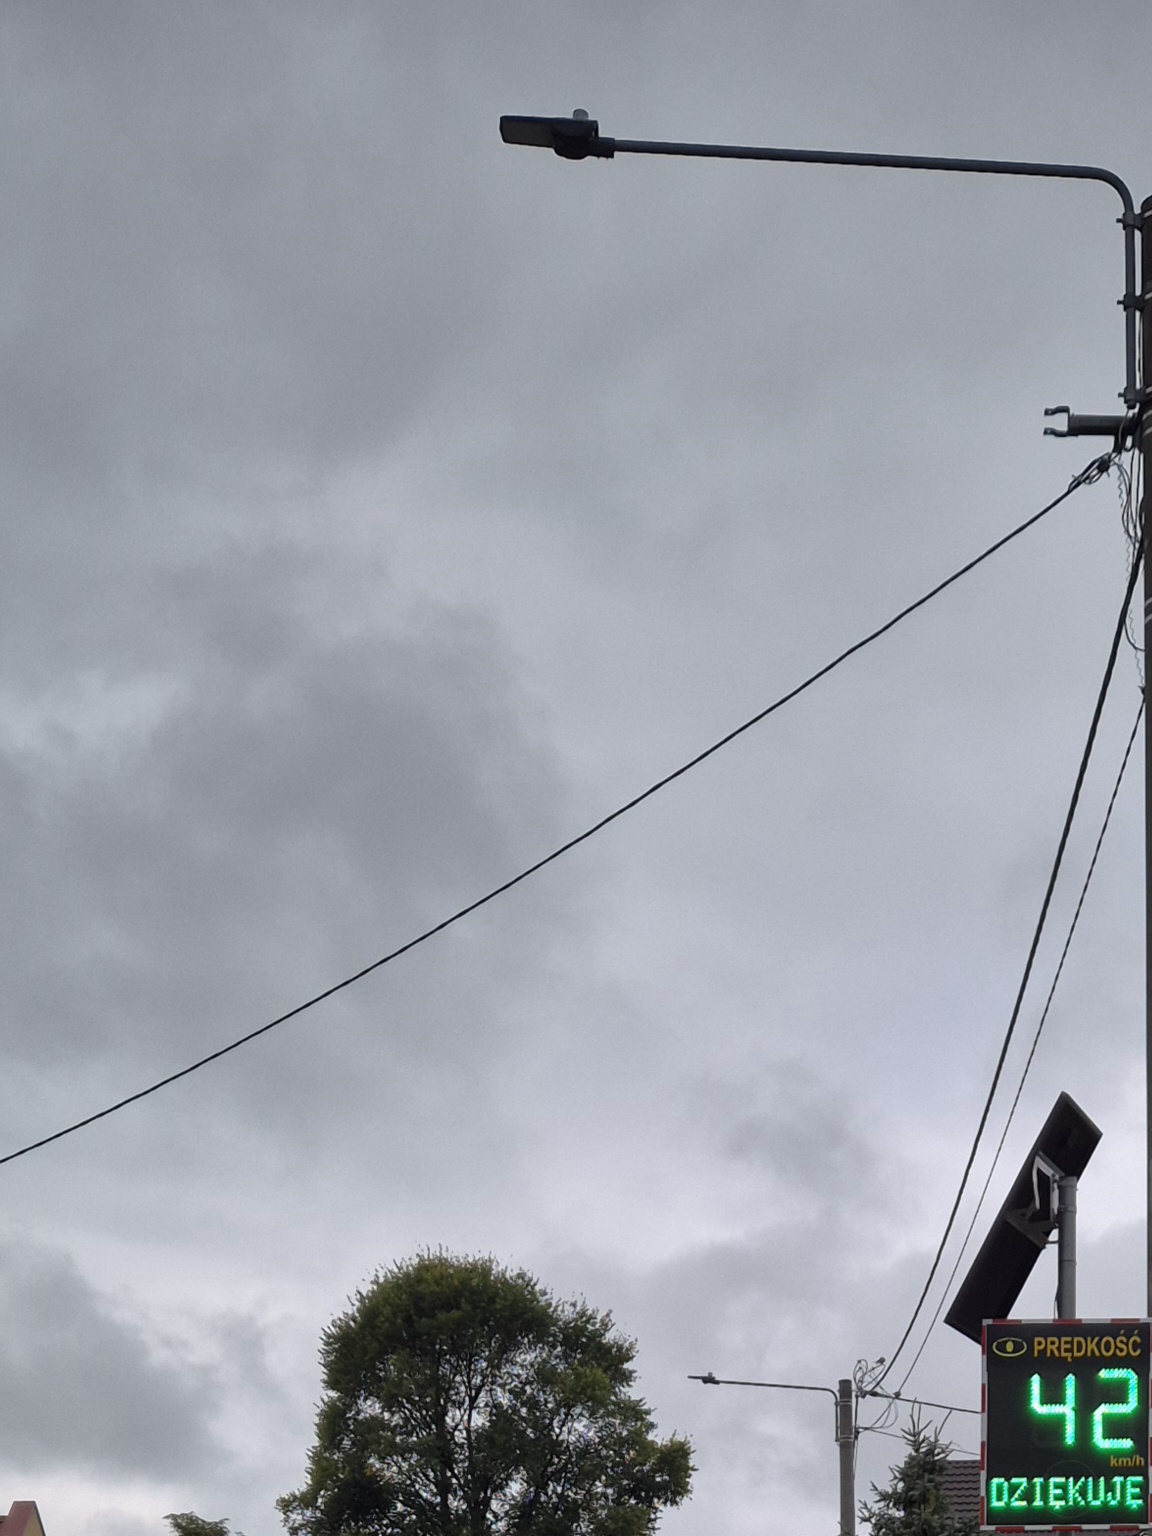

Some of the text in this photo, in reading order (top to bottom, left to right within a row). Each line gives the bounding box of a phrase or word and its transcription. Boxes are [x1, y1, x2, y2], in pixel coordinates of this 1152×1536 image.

[1033, 1330, 1142, 1362] PRĘDKOŚĆ
[1029, 1367, 1139, 1449] 42
[1109, 1455, 1145, 1468] km/h
[989, 1476, 1144, 1510] DZIĘKUJĘ
